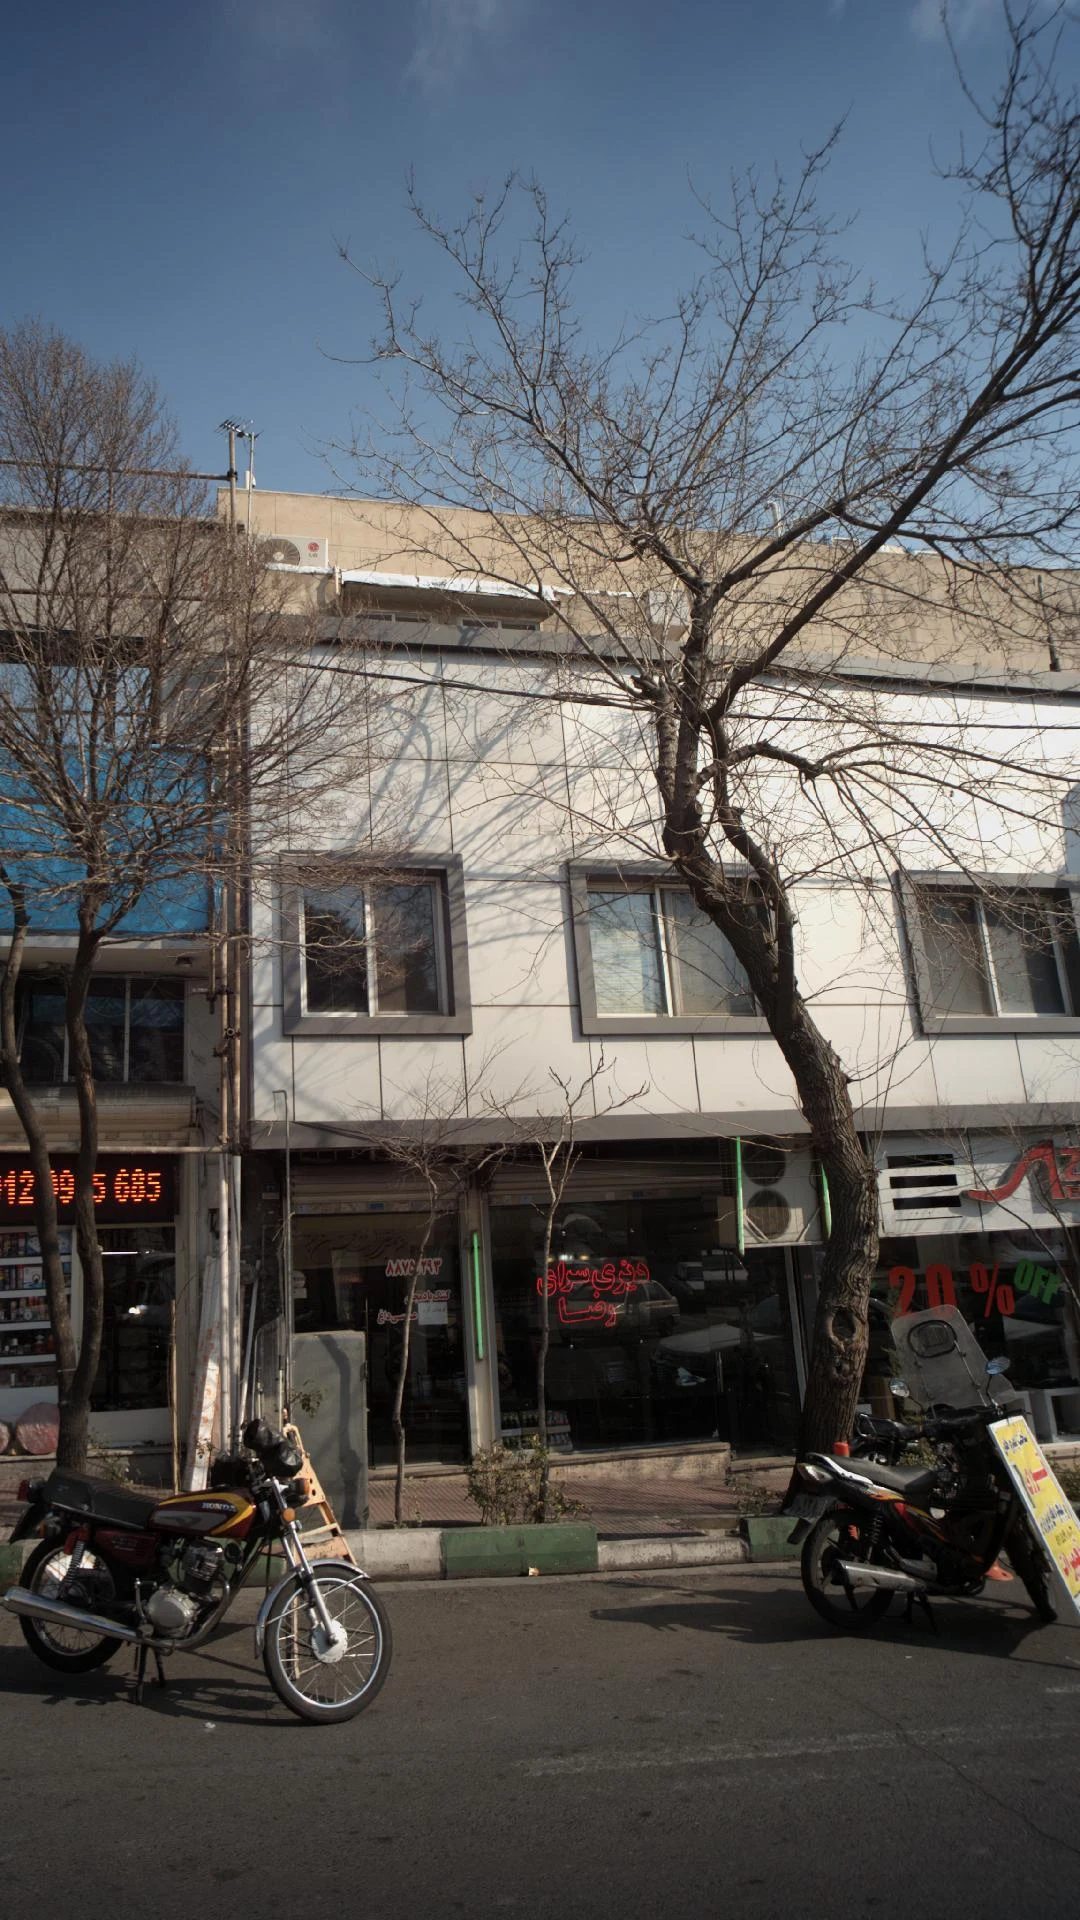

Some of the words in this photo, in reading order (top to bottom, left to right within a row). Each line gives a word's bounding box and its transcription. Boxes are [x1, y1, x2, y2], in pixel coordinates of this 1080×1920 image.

[0, 1170, 34, 1204] 12
[114, 1168, 161, 1202] 685
[1013, 1258, 1061, 1305] OFF
[201, 1502, 236, 1512] HONDA
